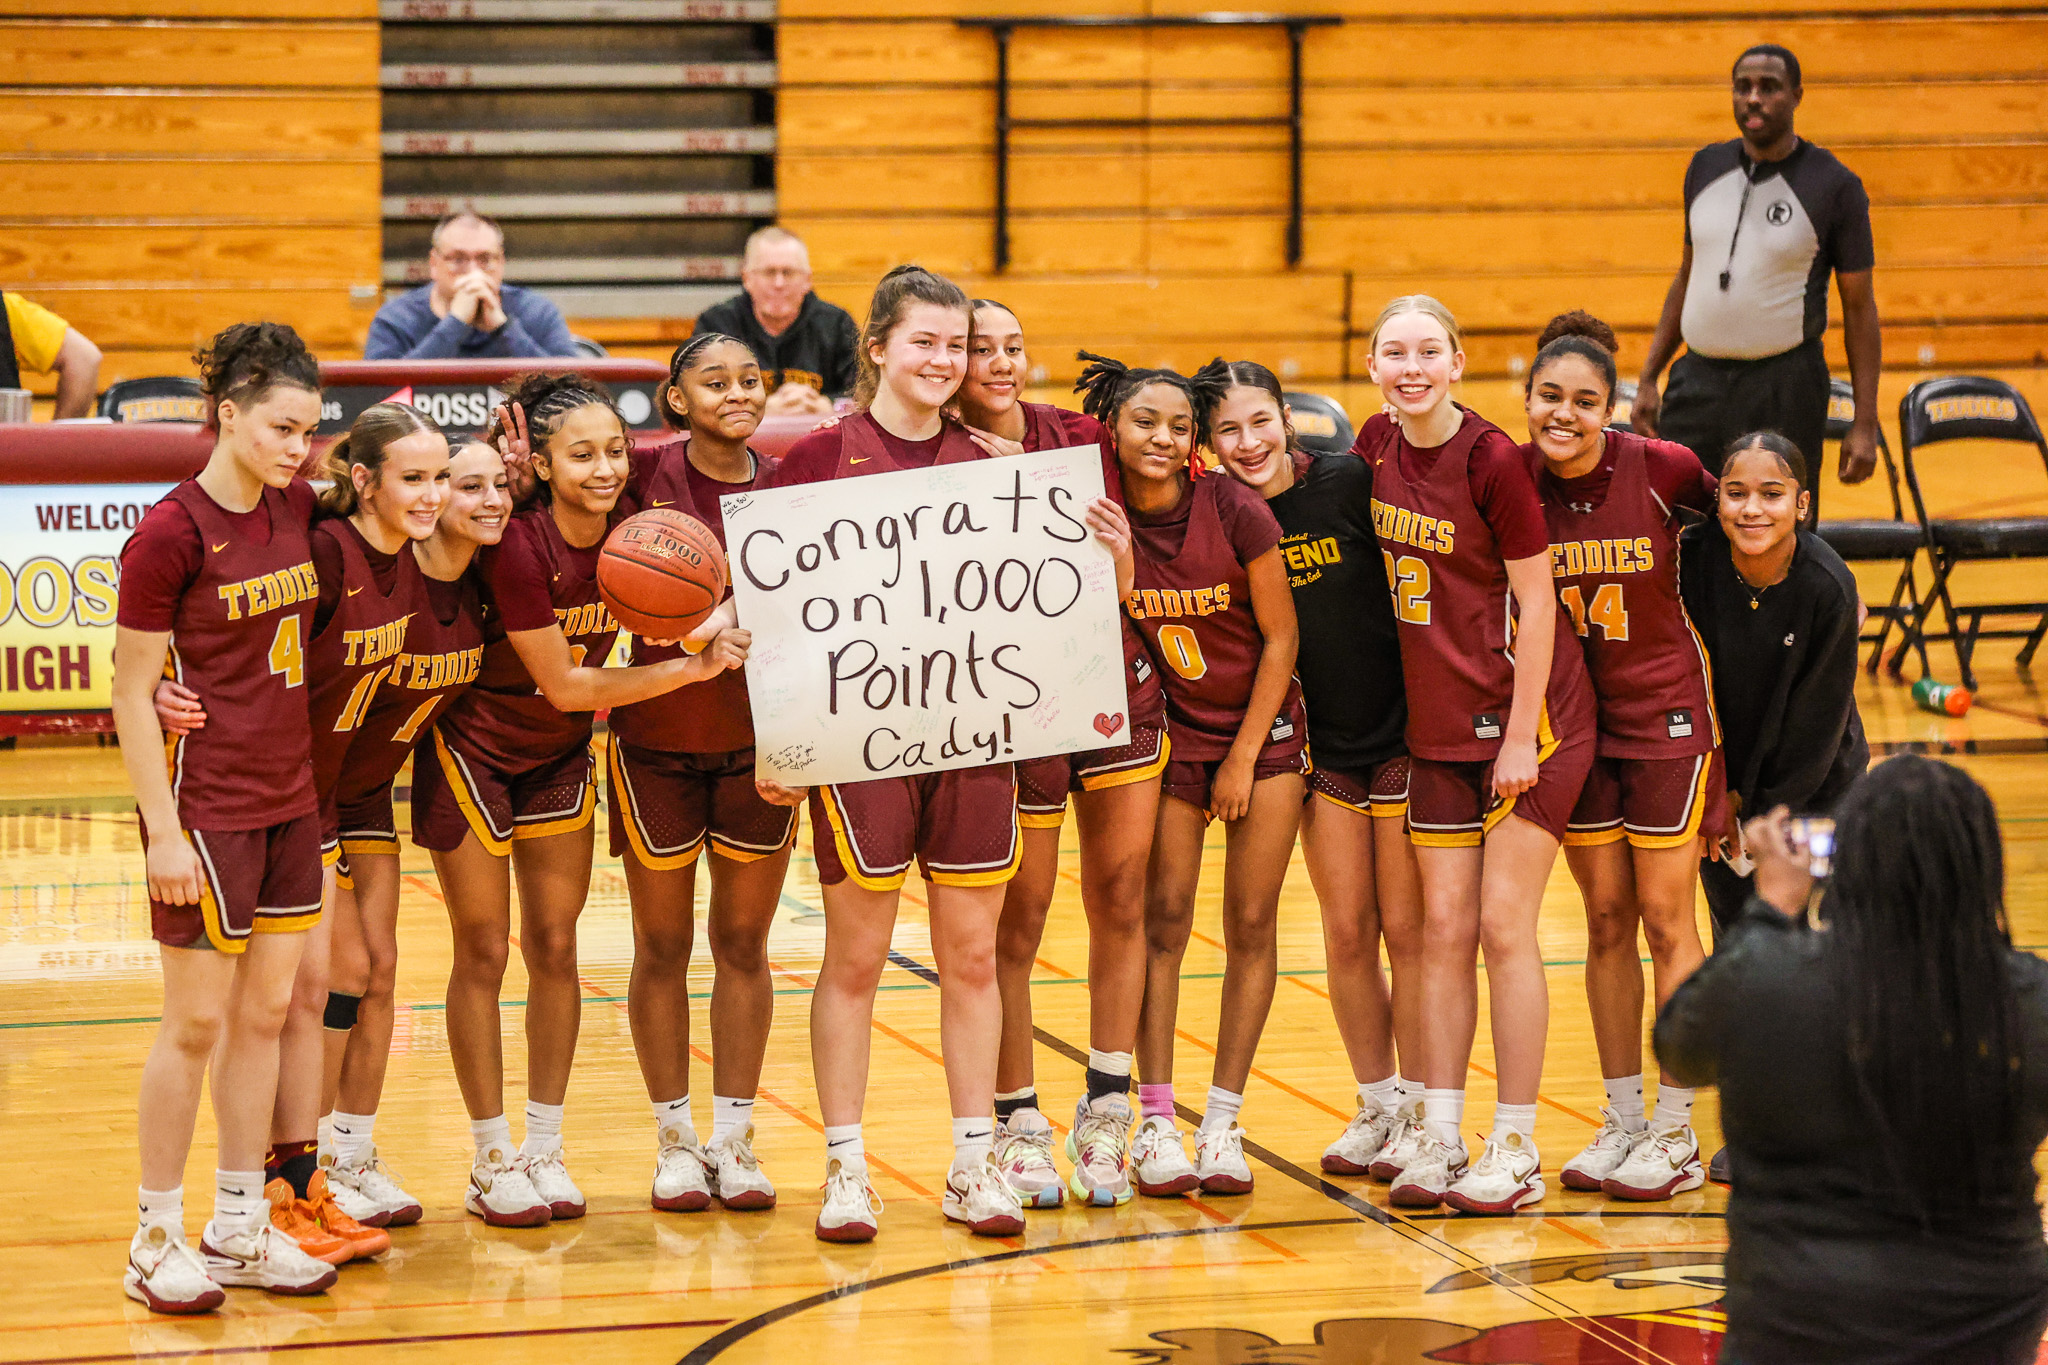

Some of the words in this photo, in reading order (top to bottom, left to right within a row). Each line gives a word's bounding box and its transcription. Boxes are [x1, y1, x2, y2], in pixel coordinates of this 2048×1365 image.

[1926, 396, 2017, 423] TEDDIES
[36, 504, 151, 530] WELCO
[740, 470, 1088, 591] Congrats
[802, 594, 888, 632] on
[920, 558, 1082, 624] 1,000
[1560, 583, 1629, 641] 14
[0, 645, 91, 692] IGH
[268, 613, 304, 689] 4
[387, 643, 485, 690] TEDDIE
[828, 631, 1041, 714] Points
[1157, 624, 1208, 680] 0
[863, 713, 1014, 772] Cady!
[1275, 717, 1284, 725] S
[1482, 716, 1490, 725] L
[1673, 714, 1684, 724] M
